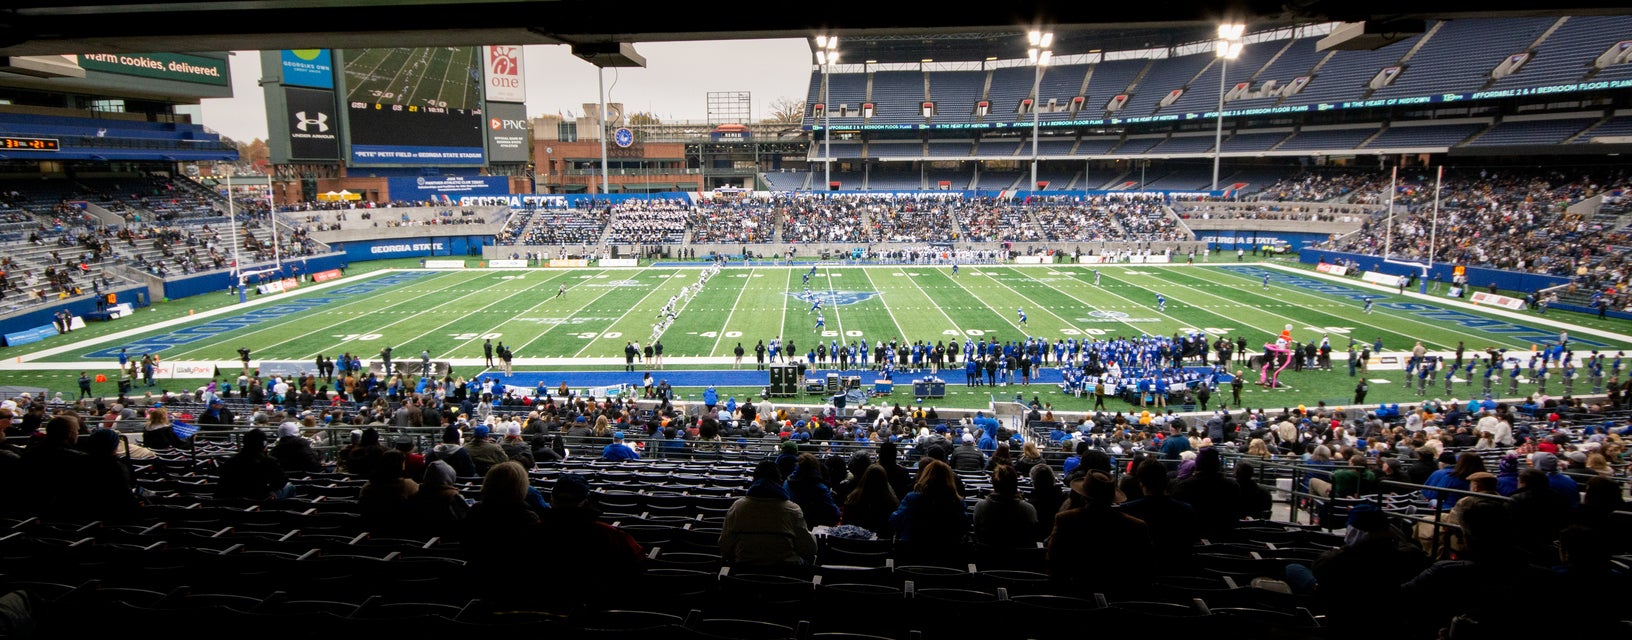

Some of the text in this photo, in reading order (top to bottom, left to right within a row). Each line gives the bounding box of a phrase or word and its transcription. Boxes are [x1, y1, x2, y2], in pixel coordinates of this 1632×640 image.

[84, 53, 220, 77] Warm cookies, delivered.
[492, 76, 519, 88] one
[1471, 90, 1514, 99] AFFORDABLE
[1537, 84, 1577, 93] BEDROOM
[1578, 81, 1608, 90] FLOOR
[1365, 99, 1386, 107] HEART
[1399, 96, 1431, 104] MIDTOWN
[502, 119, 526, 130] PNC
[370, 242, 444, 254] GEORGIA STATE
[340, 333, 383, 341] 10
[453, 332, 503, 340] 20
[176, 366, 210, 374] WallyPark
